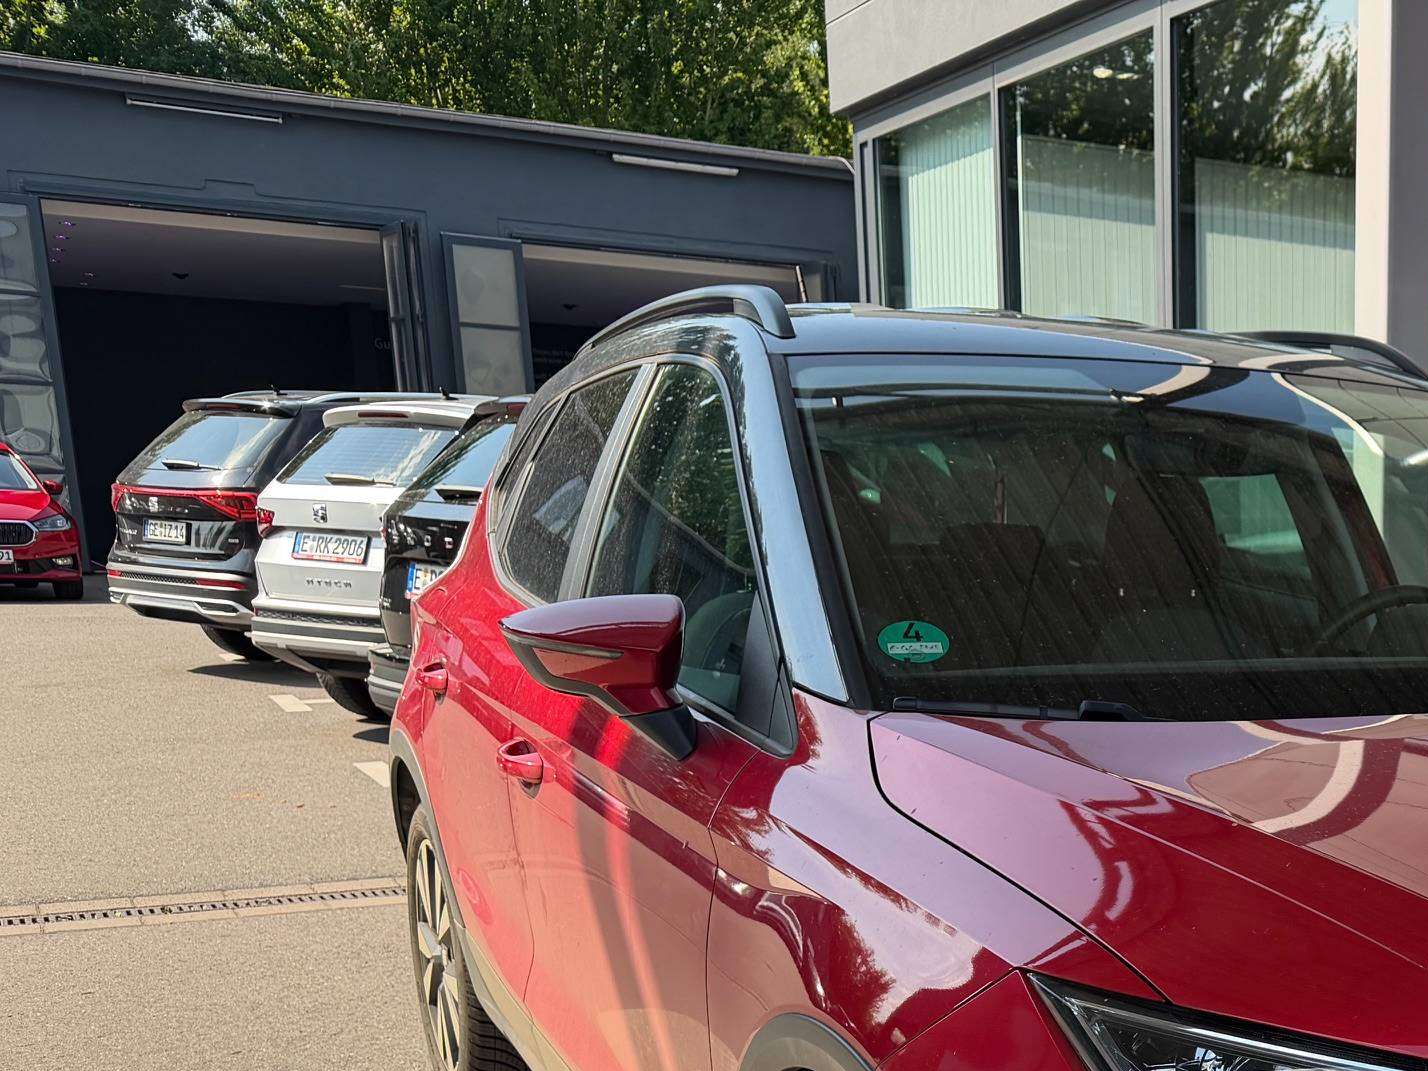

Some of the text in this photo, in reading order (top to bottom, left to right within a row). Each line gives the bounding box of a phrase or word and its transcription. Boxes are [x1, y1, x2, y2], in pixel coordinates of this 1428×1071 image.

[301, 535, 364, 557] E RK 2906
[902, 622, 923, 642] 4
